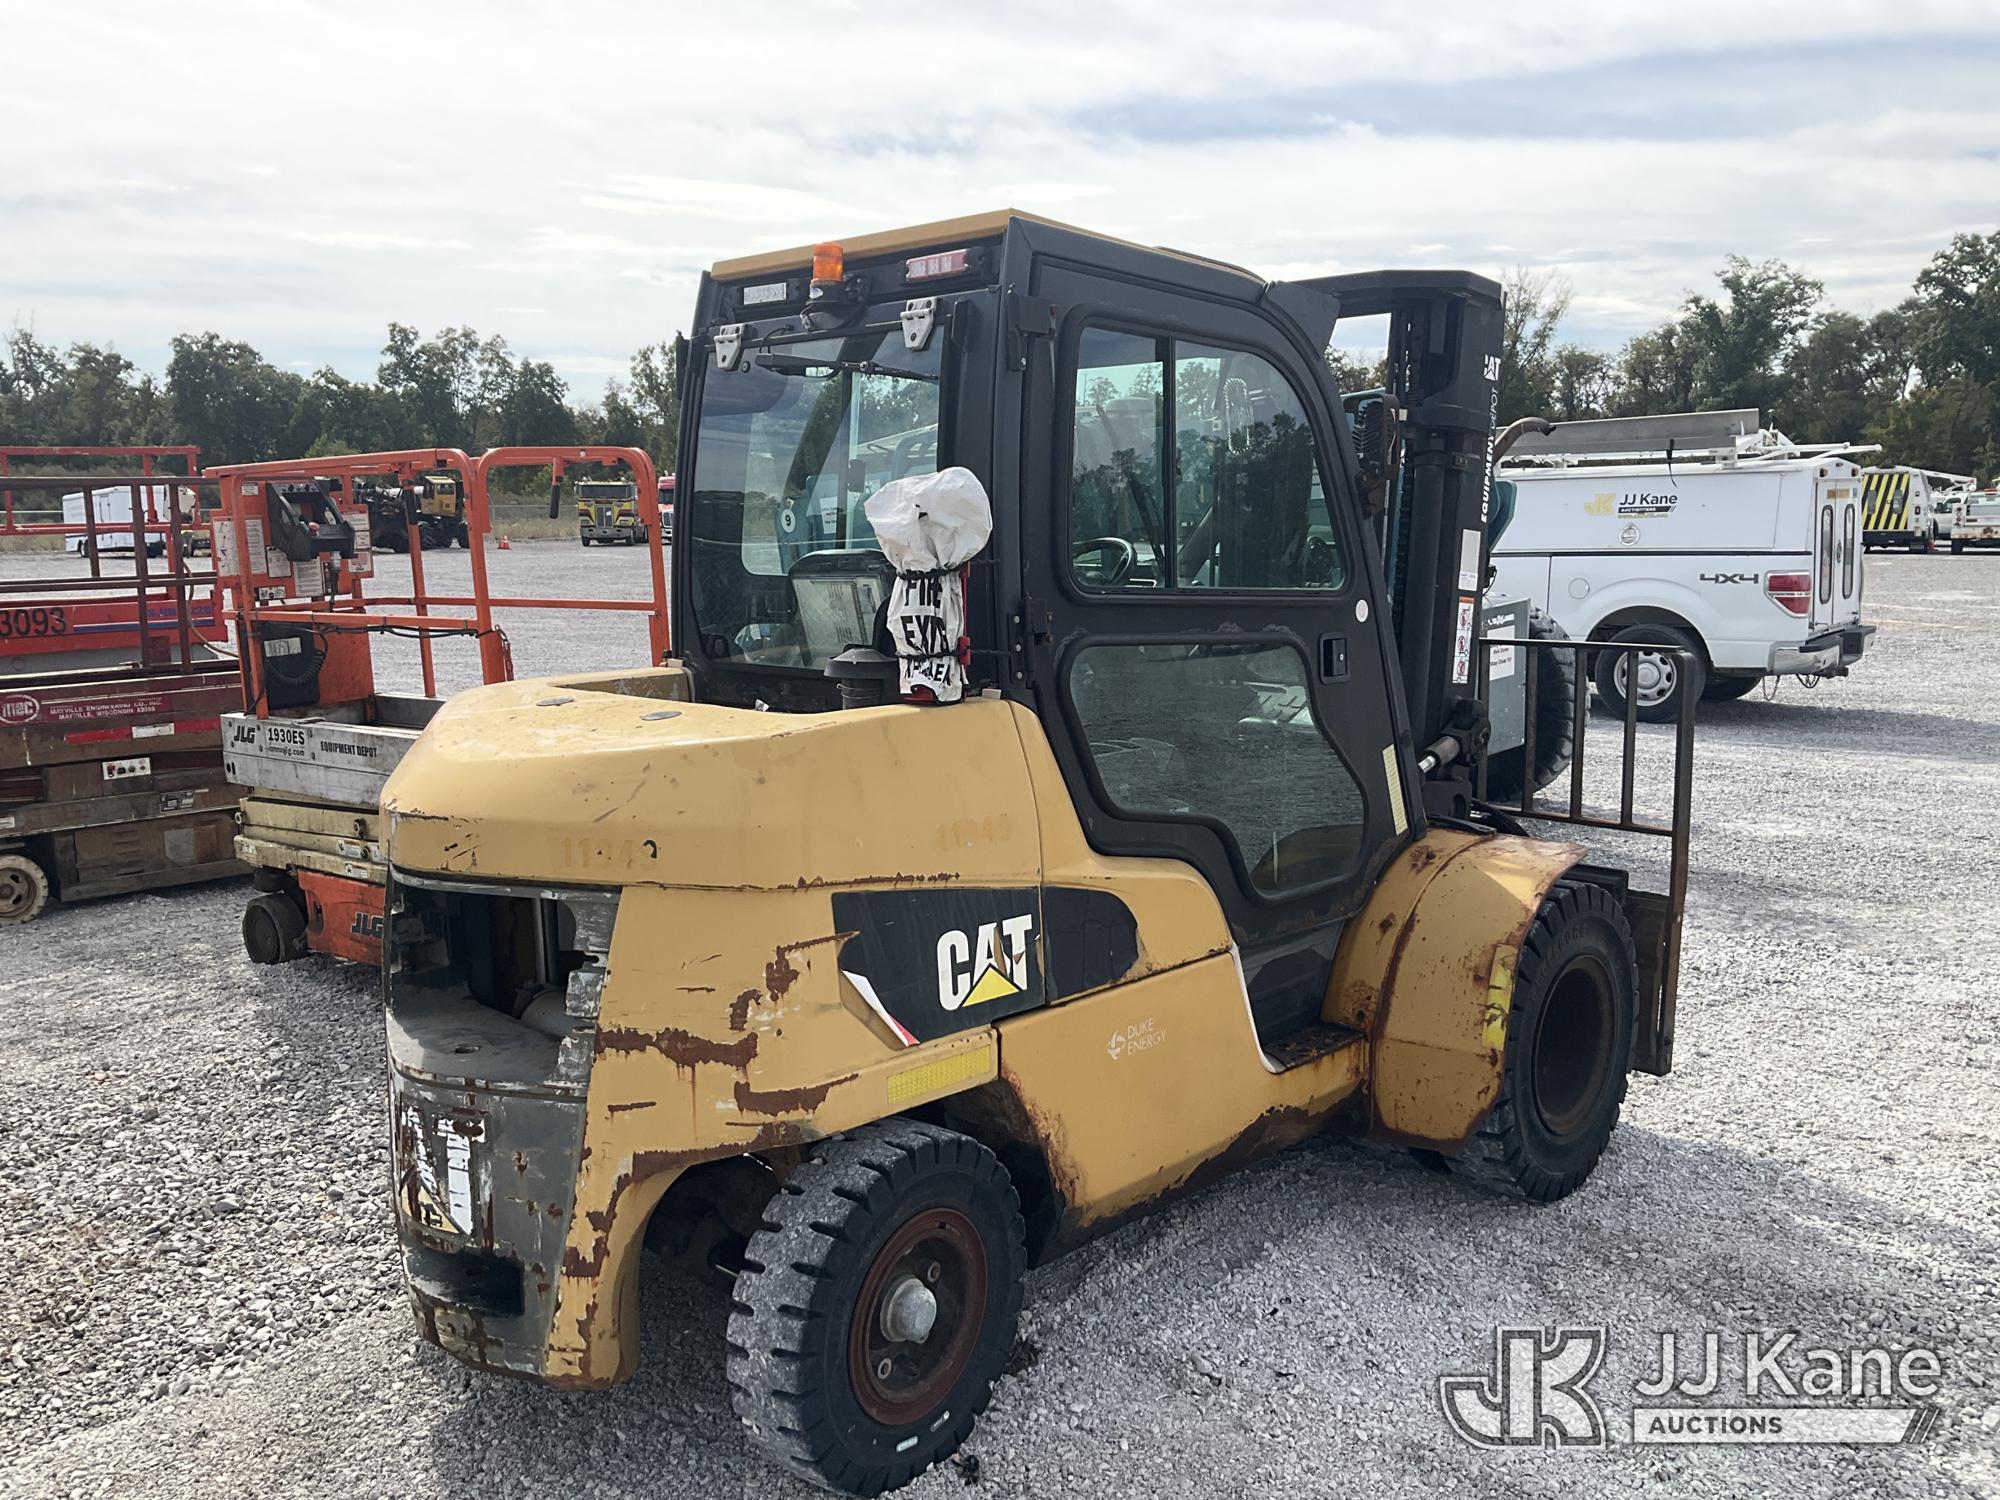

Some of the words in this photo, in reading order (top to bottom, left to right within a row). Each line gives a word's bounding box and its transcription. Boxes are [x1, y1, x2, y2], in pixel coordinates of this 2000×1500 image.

[1490, 387, 1499, 430] DEPOT
[1619, 493, 1637, 506] JJ
[1639, 493, 1678, 506] Kane
[784, 514, 792, 527] 9
[0, 606, 67, 638] 3093
[96, 708, 133, 717] WISCONSIN
[233, 725, 256, 744] JLG
[268, 727, 305, 745] 1930ES
[320, 741, 356, 755] EQUIPMENT
[356, 745, 377, 758] DEPOT
[350, 911, 385, 939] JLG
[937, 913, 1033, 1011] CAT
[1127, 1017, 1154, 1040] DUKE
[1127, 1029, 1167, 1056] ENERGY
